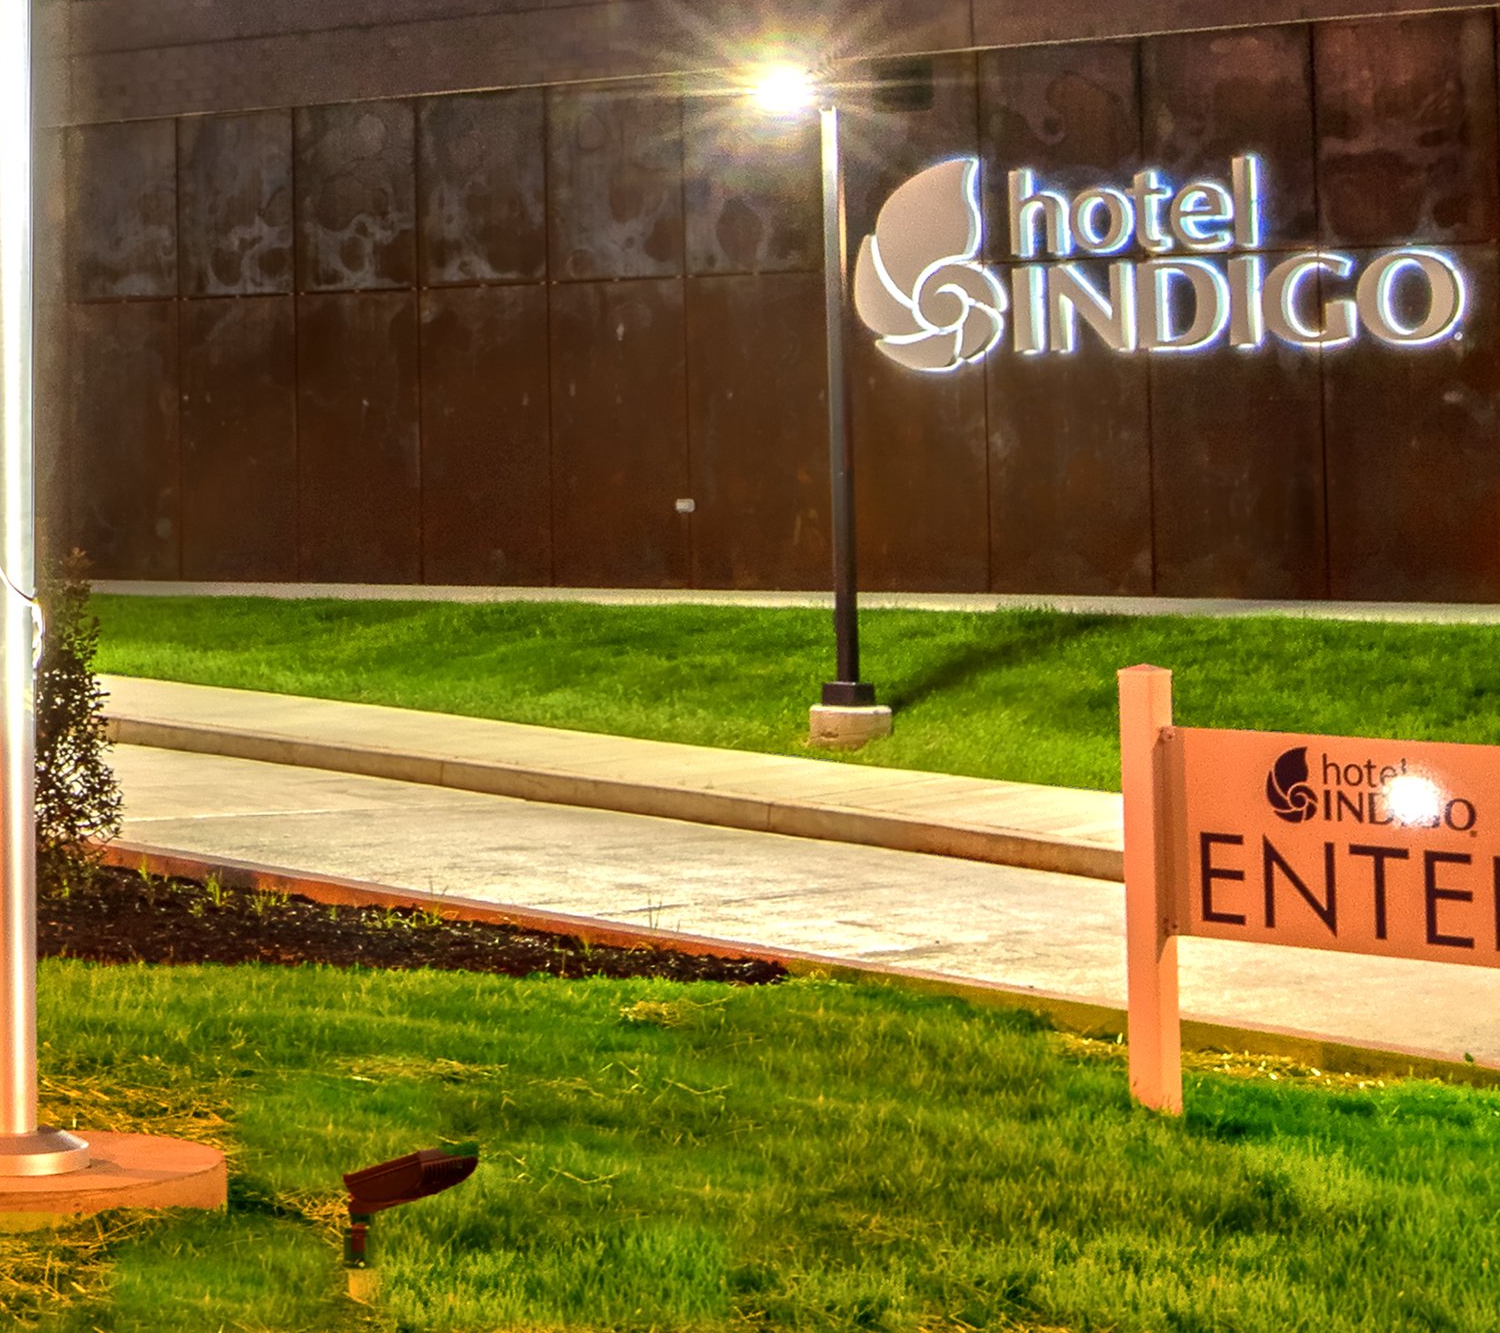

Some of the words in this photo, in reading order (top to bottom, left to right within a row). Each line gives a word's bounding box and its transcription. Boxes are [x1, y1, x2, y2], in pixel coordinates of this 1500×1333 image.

[1008, 153, 1262, 256] hotel
[1012, 249, 1466, 353] INDIGO
[1323, 788, 1477, 832] INDO
